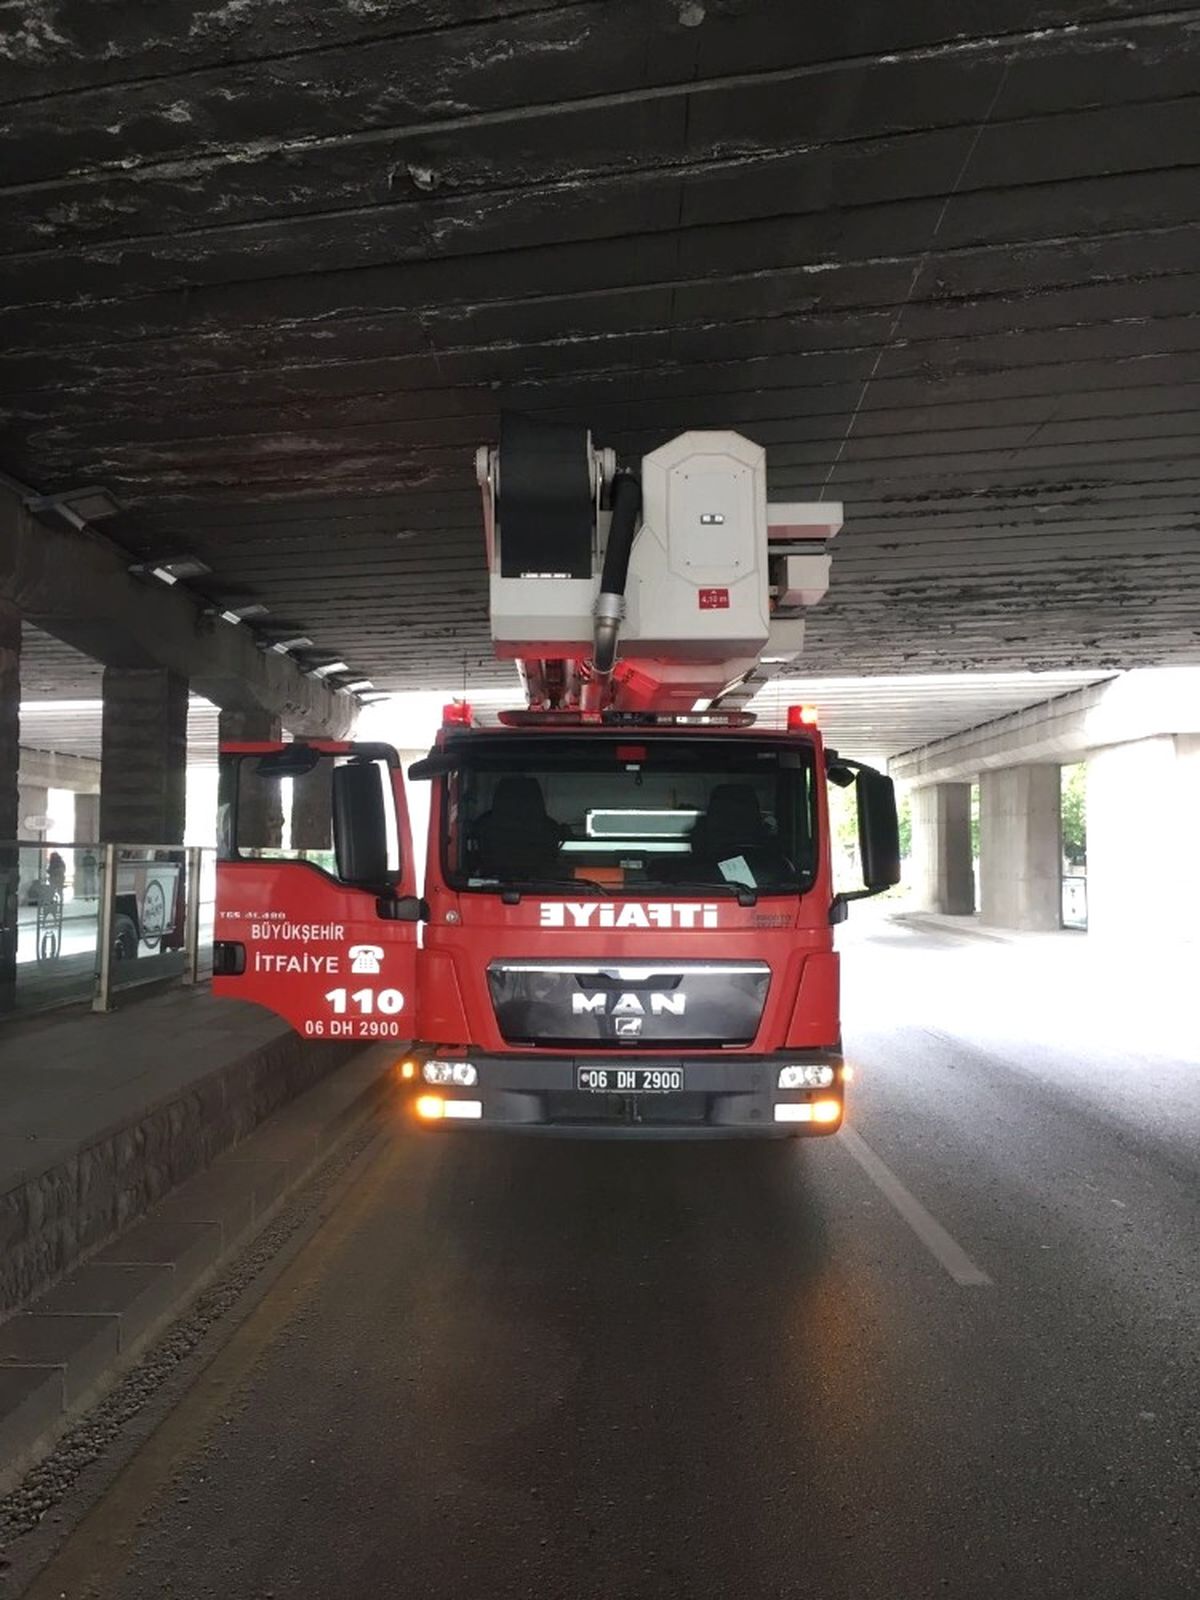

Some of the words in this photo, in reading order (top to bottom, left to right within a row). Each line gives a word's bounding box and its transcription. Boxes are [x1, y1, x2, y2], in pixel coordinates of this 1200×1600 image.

[251, 922, 345, 943] BÜYÜKŞEHİR
[255, 951, 339, 973] İTFAİYE
[325, 988, 404, 1014] 110
[572, 993, 686, 1015] MAN
[305, 1021, 324, 1035] 06
[330, 1021, 353, 1035] DH
[360, 1022, 399, 1036] 2900
[589, 1071, 607, 1088] 06
[617, 1071, 636, 1088] DH
[643, 1072, 680, 1089] 2900
